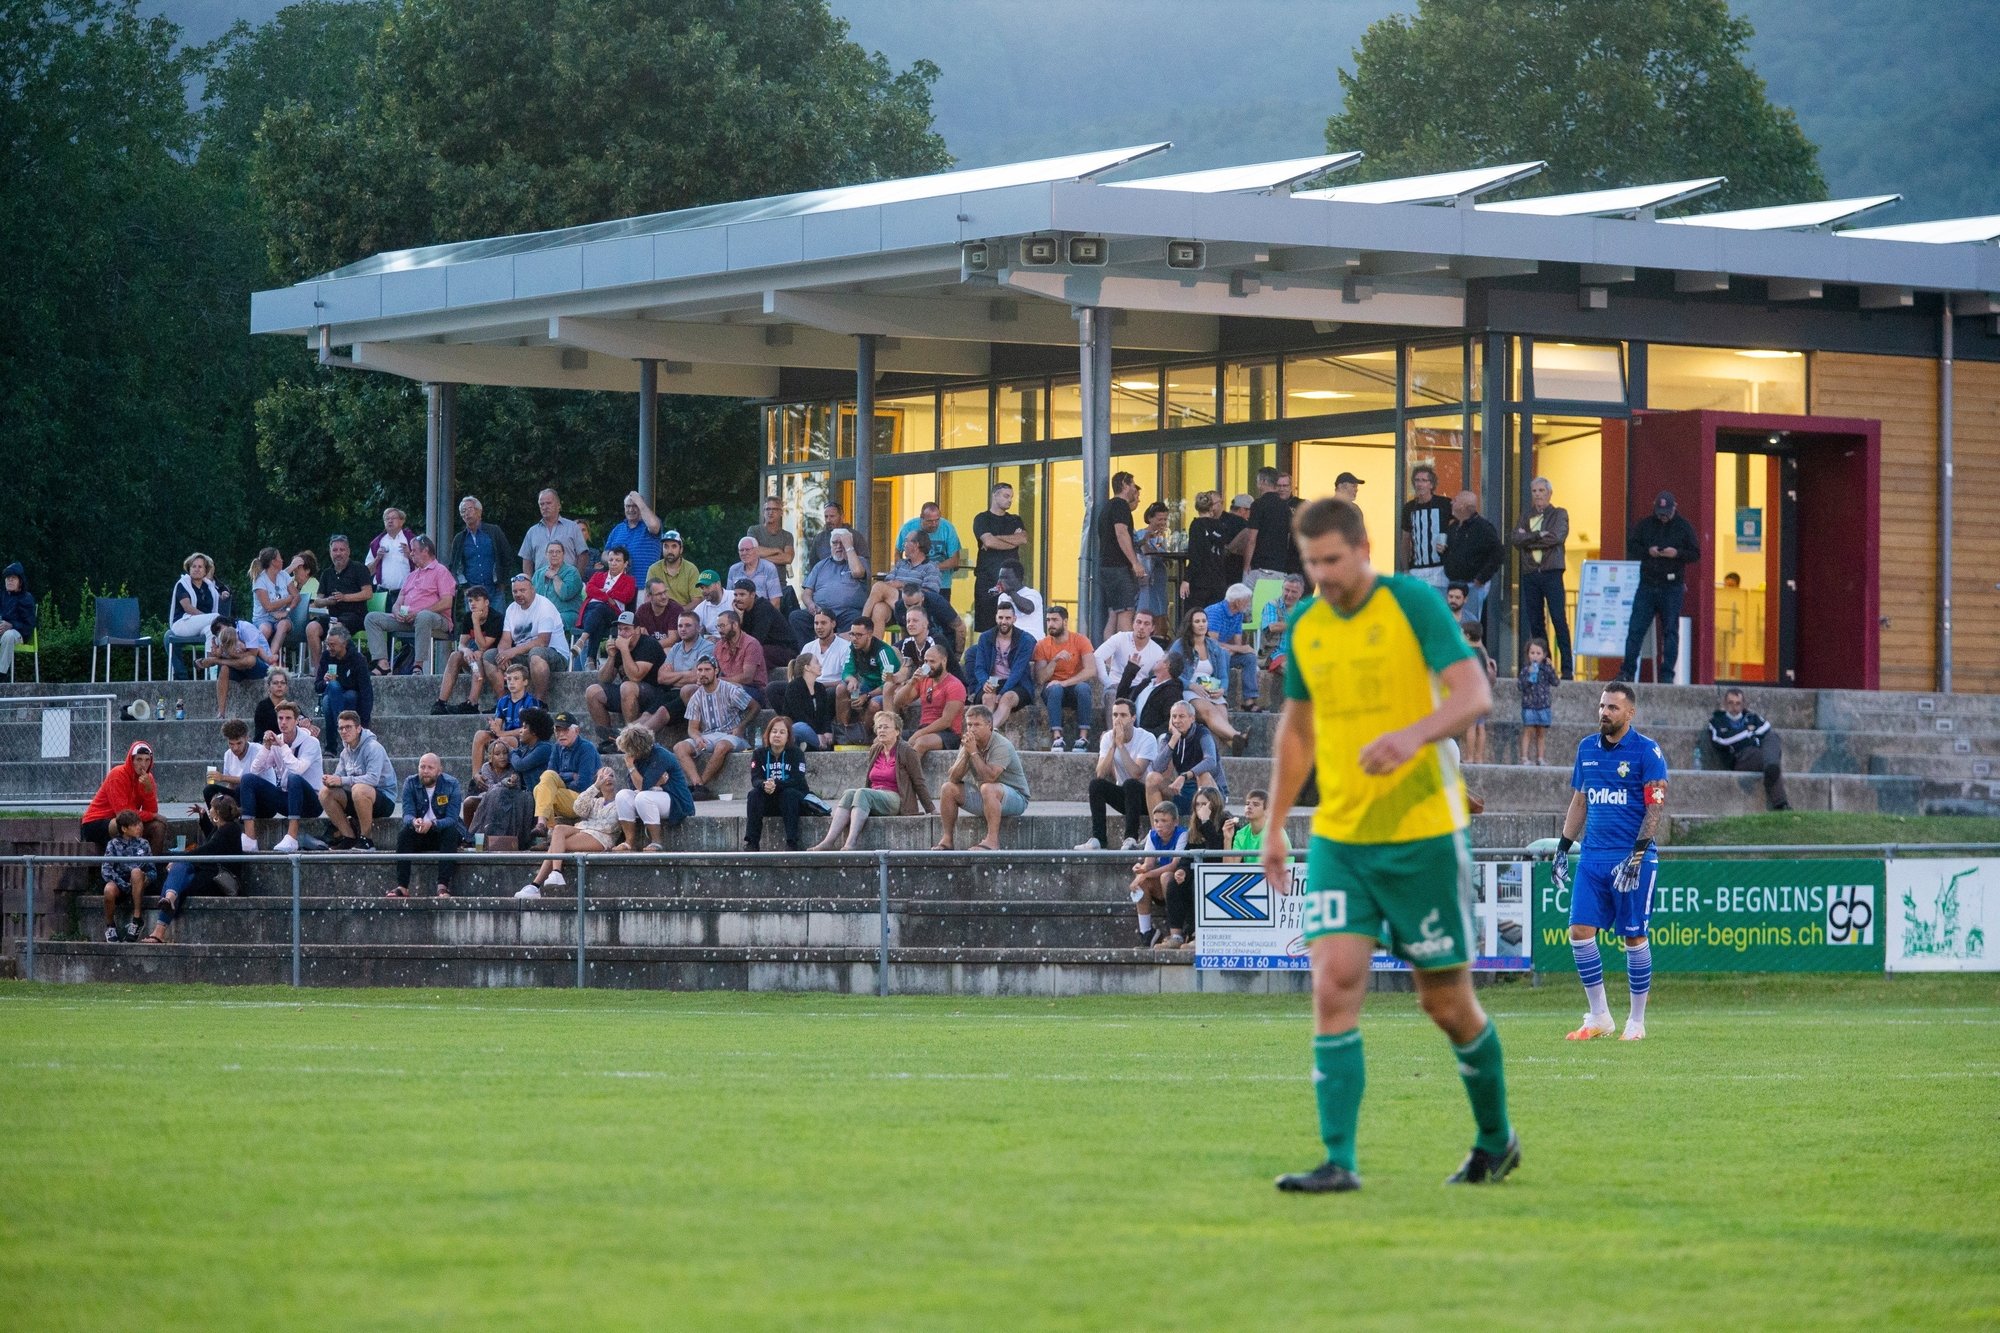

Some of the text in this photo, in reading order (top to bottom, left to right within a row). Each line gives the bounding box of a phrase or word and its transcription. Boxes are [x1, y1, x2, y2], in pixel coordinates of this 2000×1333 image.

[1588, 788, 1627, 805] Orllati
[1305, 889, 1347, 932] 20
[1542, 887, 1569, 913] FC
[1200, 956, 1219, 968] 022
[1221, 956, 1240, 968] 367
[1243, 956, 1254, 968] 13
[1256, 956, 1269, 968] 60
[1290, 958, 1300, 968] de
[1301, 957, 1308, 968] la
